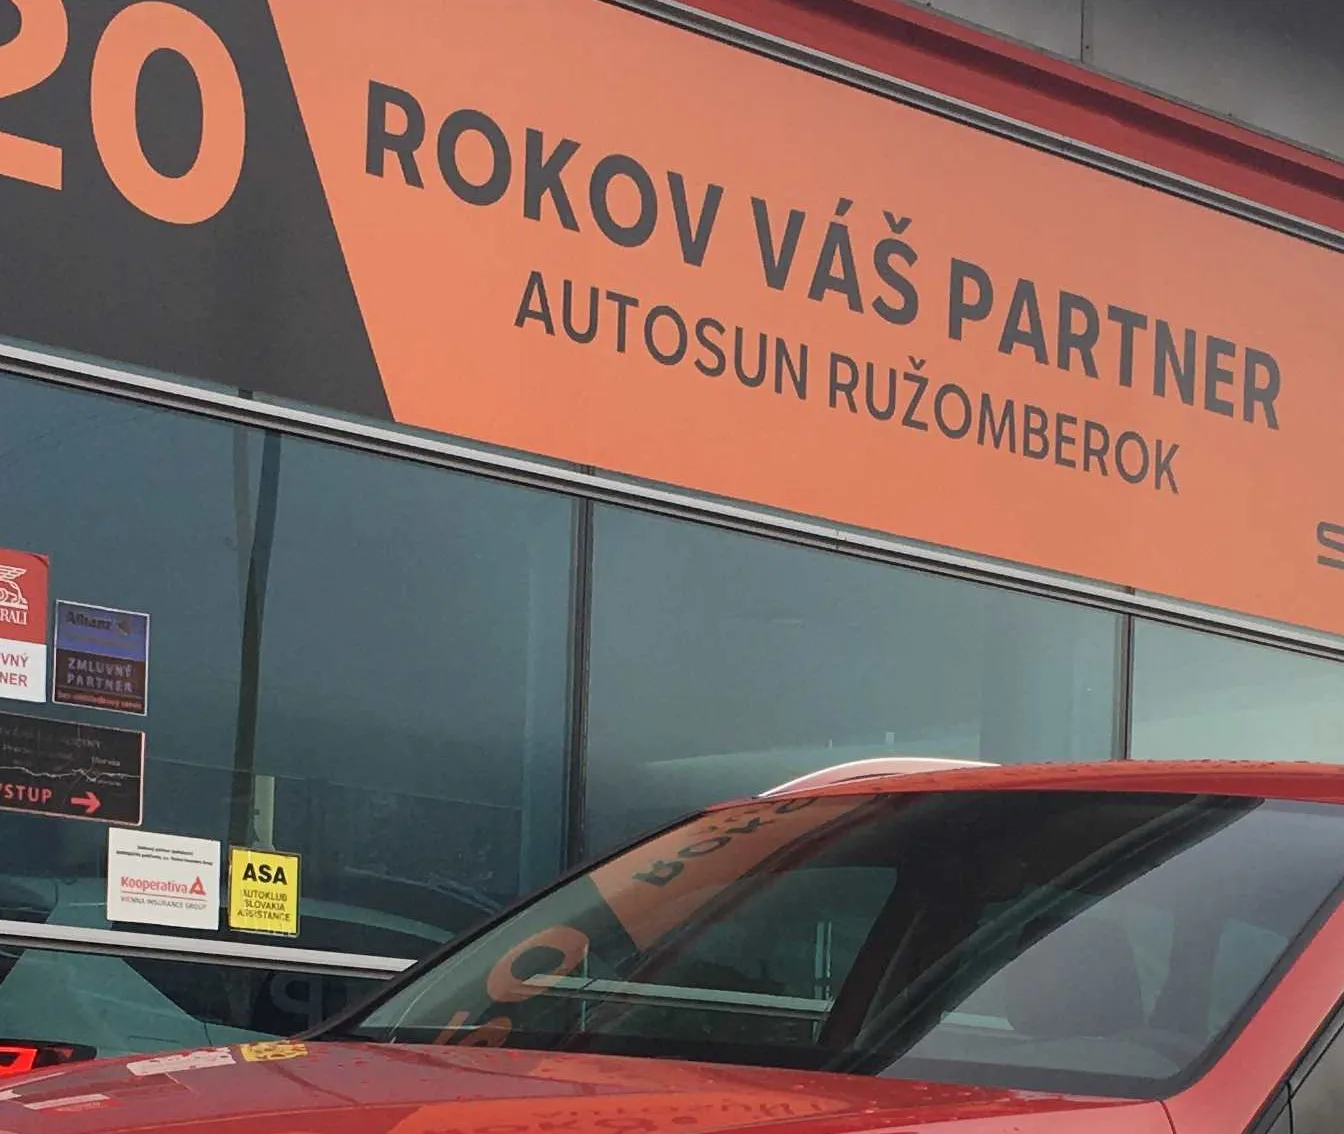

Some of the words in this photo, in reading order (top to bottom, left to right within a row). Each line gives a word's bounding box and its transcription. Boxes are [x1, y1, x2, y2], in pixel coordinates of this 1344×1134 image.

[365, 79, 723, 268] ROKOV
[751, 197, 919, 326] VÁŠ
[950, 258, 1281, 430] PARTNER
[514, 270, 809, 400] AUTOSUN
[829, 351, 1181, 494] RUŽOMBEROK
[66, 673, 134, 693] PARTNER
[242, 862, 288, 886] ASA
[120, 876, 188, 894] Kooperativa
[240, 888, 288, 902] AUTOKLUB
[243, 898, 286, 912] SLOVAKIA
